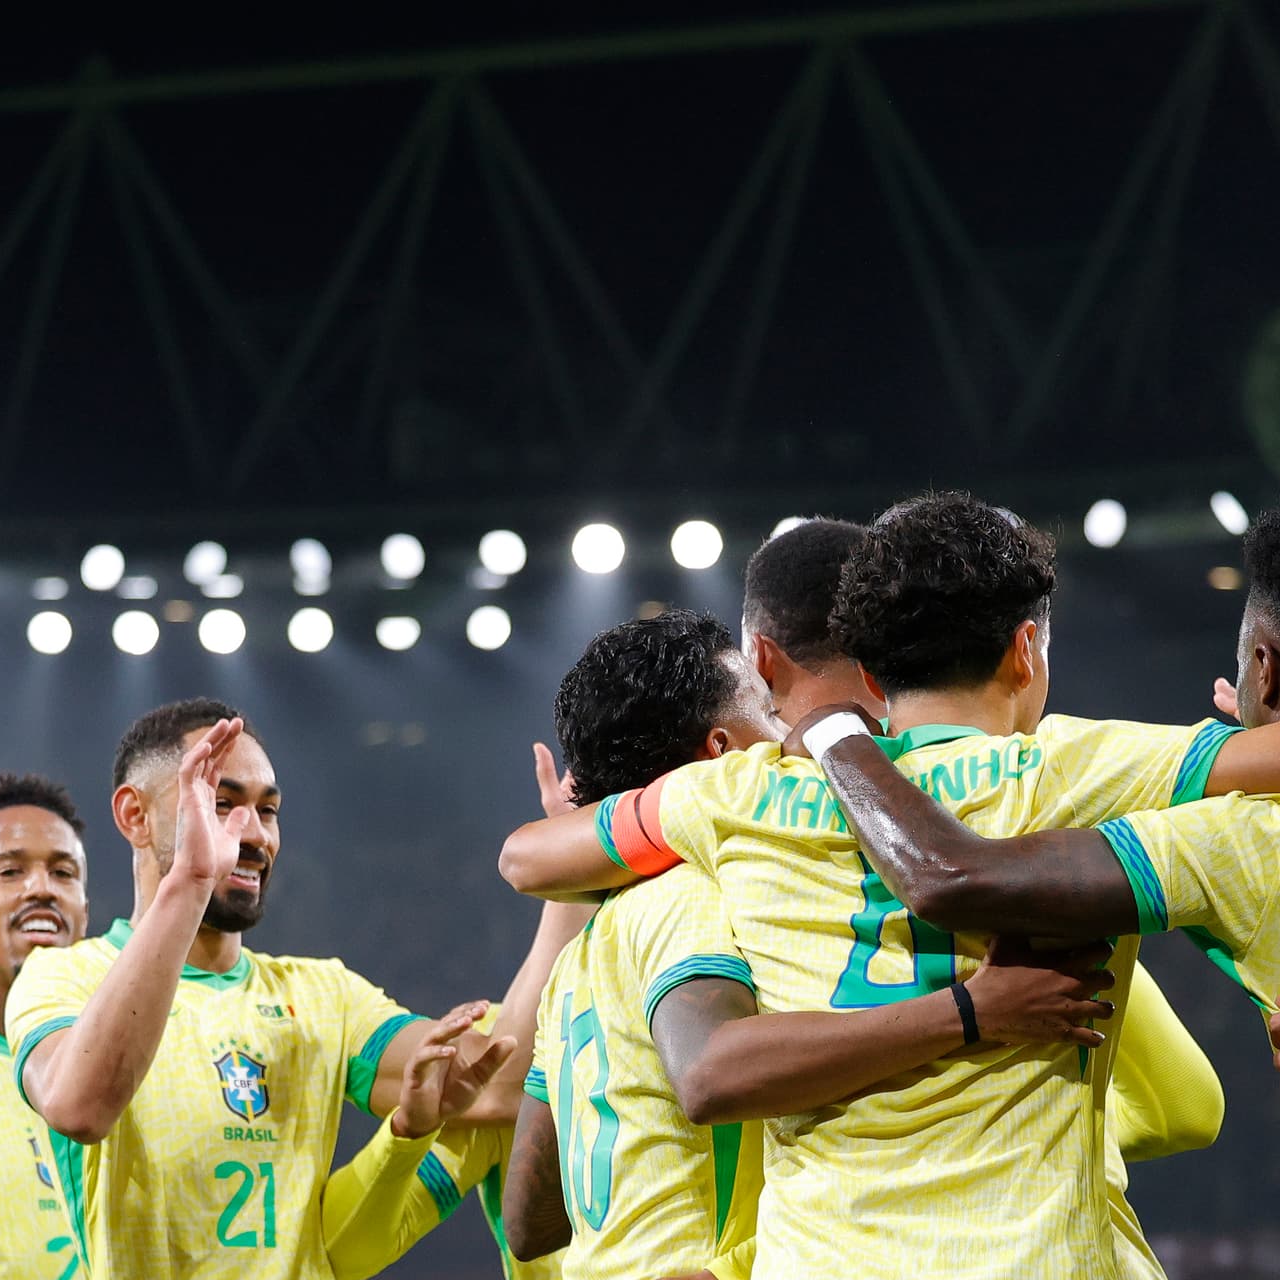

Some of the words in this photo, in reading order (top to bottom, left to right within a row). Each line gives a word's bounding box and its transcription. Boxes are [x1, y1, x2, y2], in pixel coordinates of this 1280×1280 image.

[233, 1078, 252, 1089] CBF
[223, 1126, 278, 1142] BRASIL
[214, 1160, 277, 1248] 21
